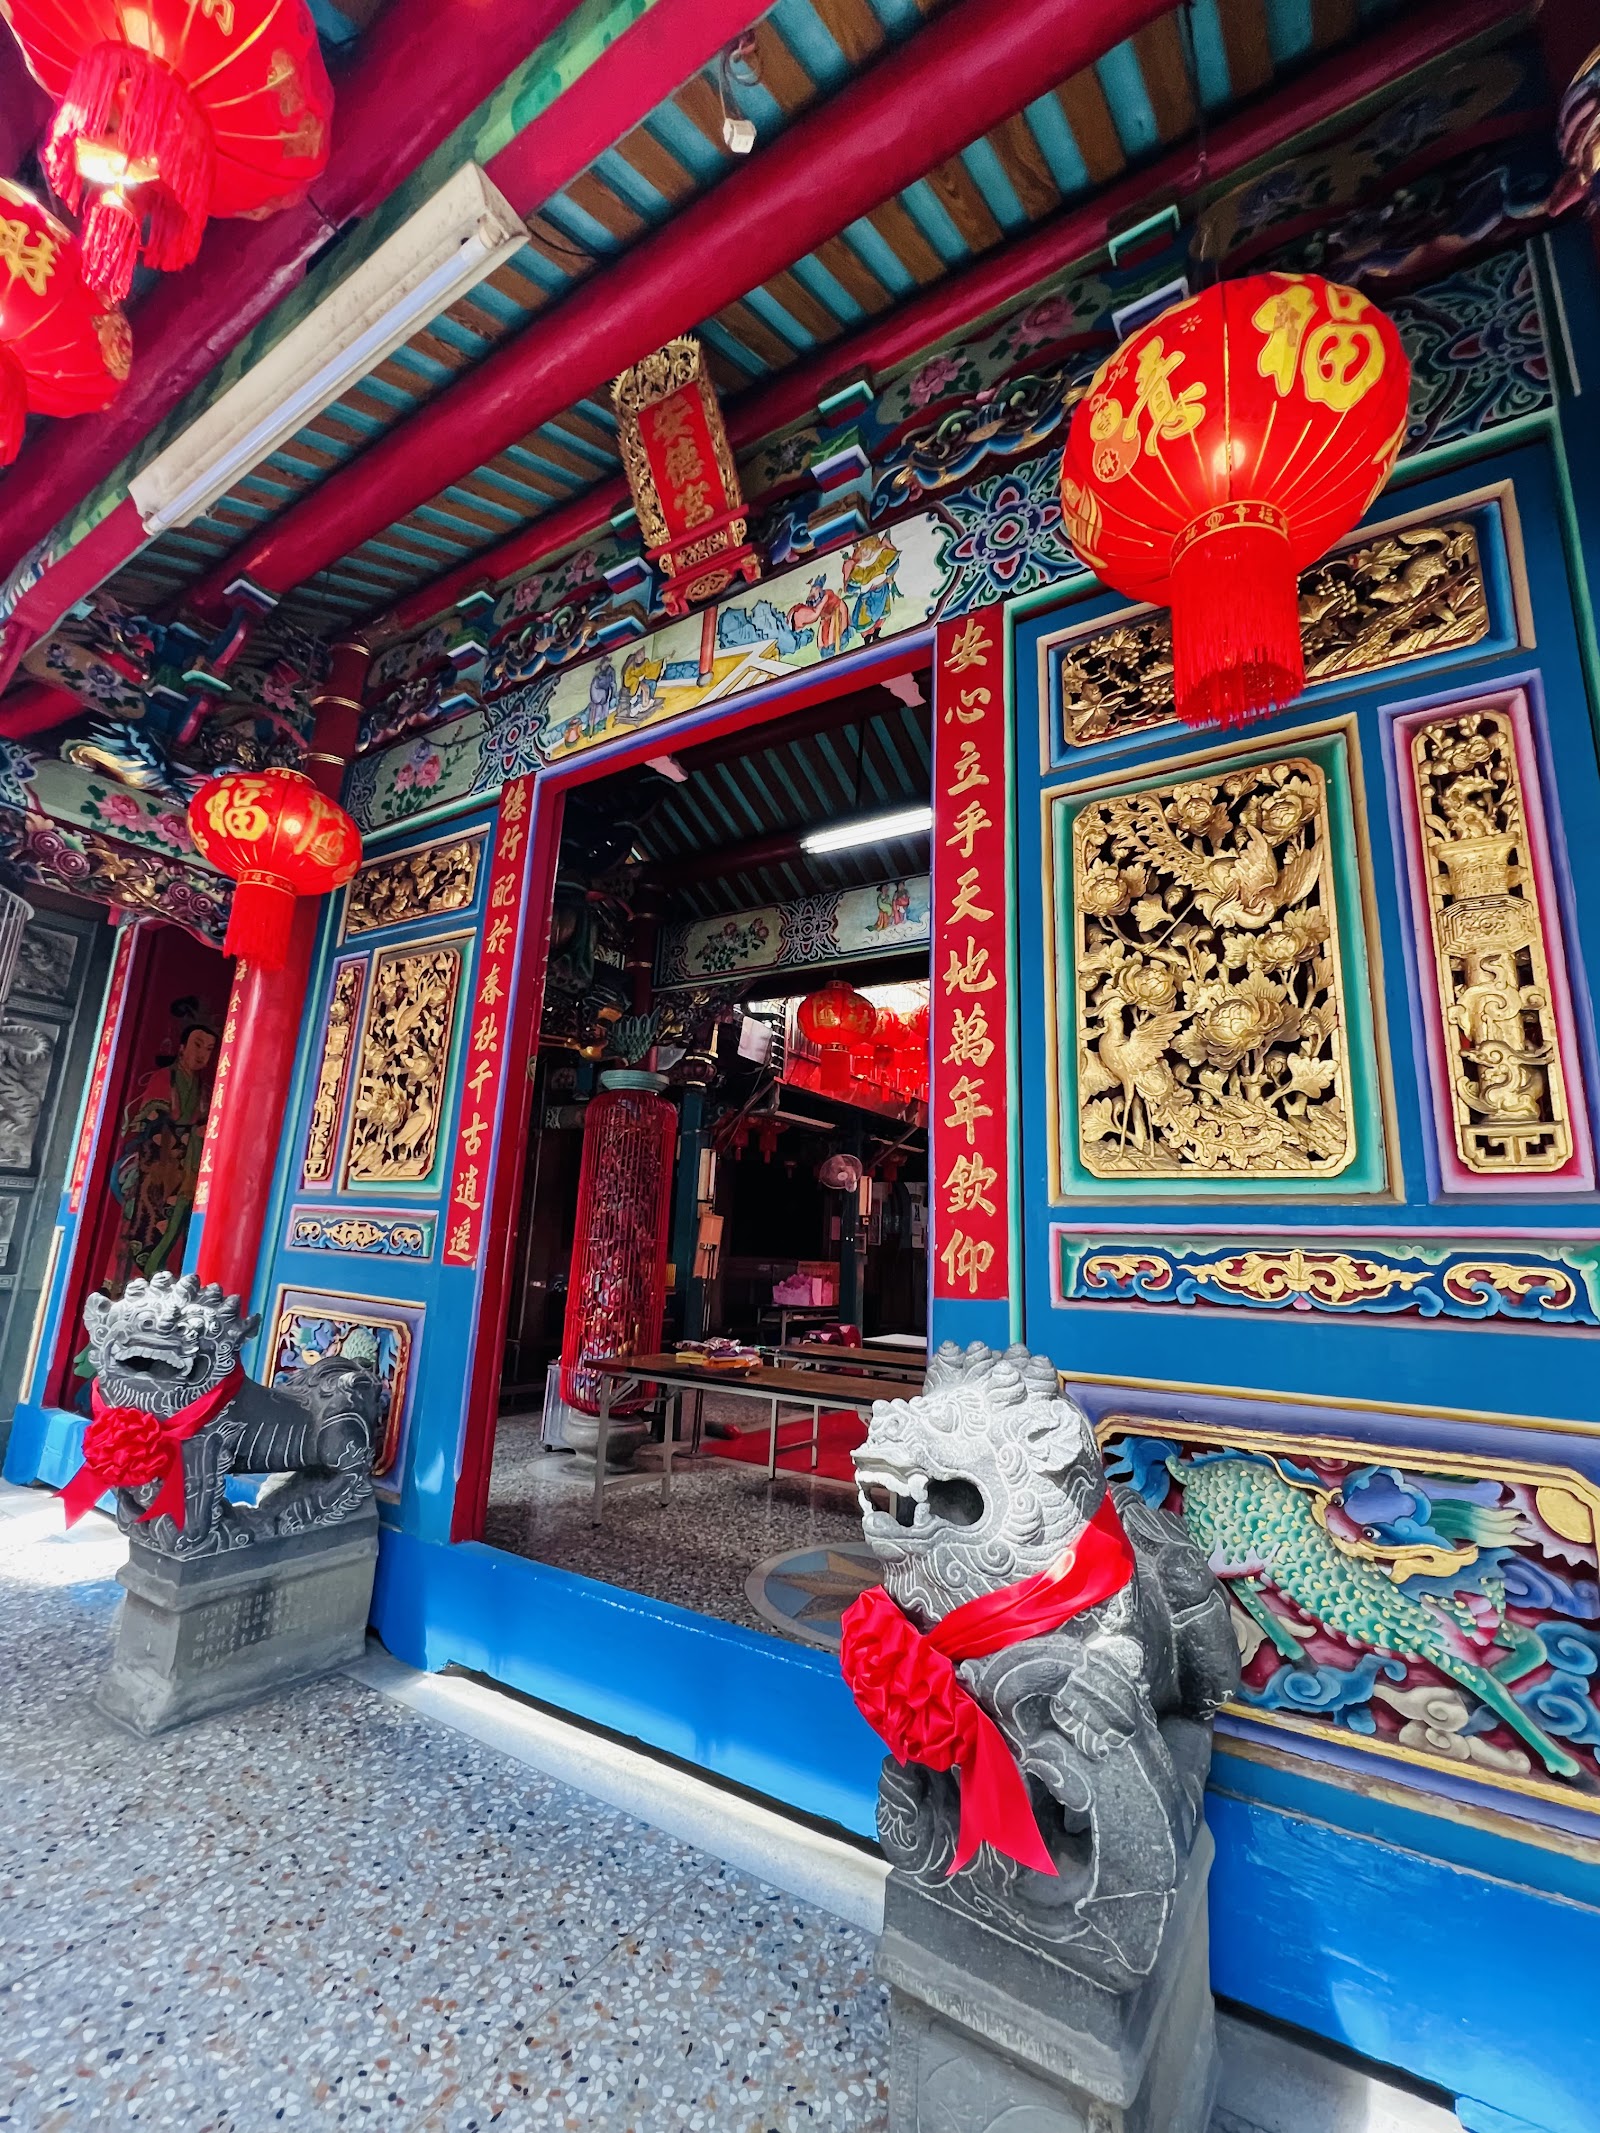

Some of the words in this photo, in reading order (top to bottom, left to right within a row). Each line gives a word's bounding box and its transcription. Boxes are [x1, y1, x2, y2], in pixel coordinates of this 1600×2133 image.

[1250, 271, 1386, 413] 福
[204, 777, 269, 842] 福
[940, 618, 998, 1294] 安心立乎天地萬年欽仰
